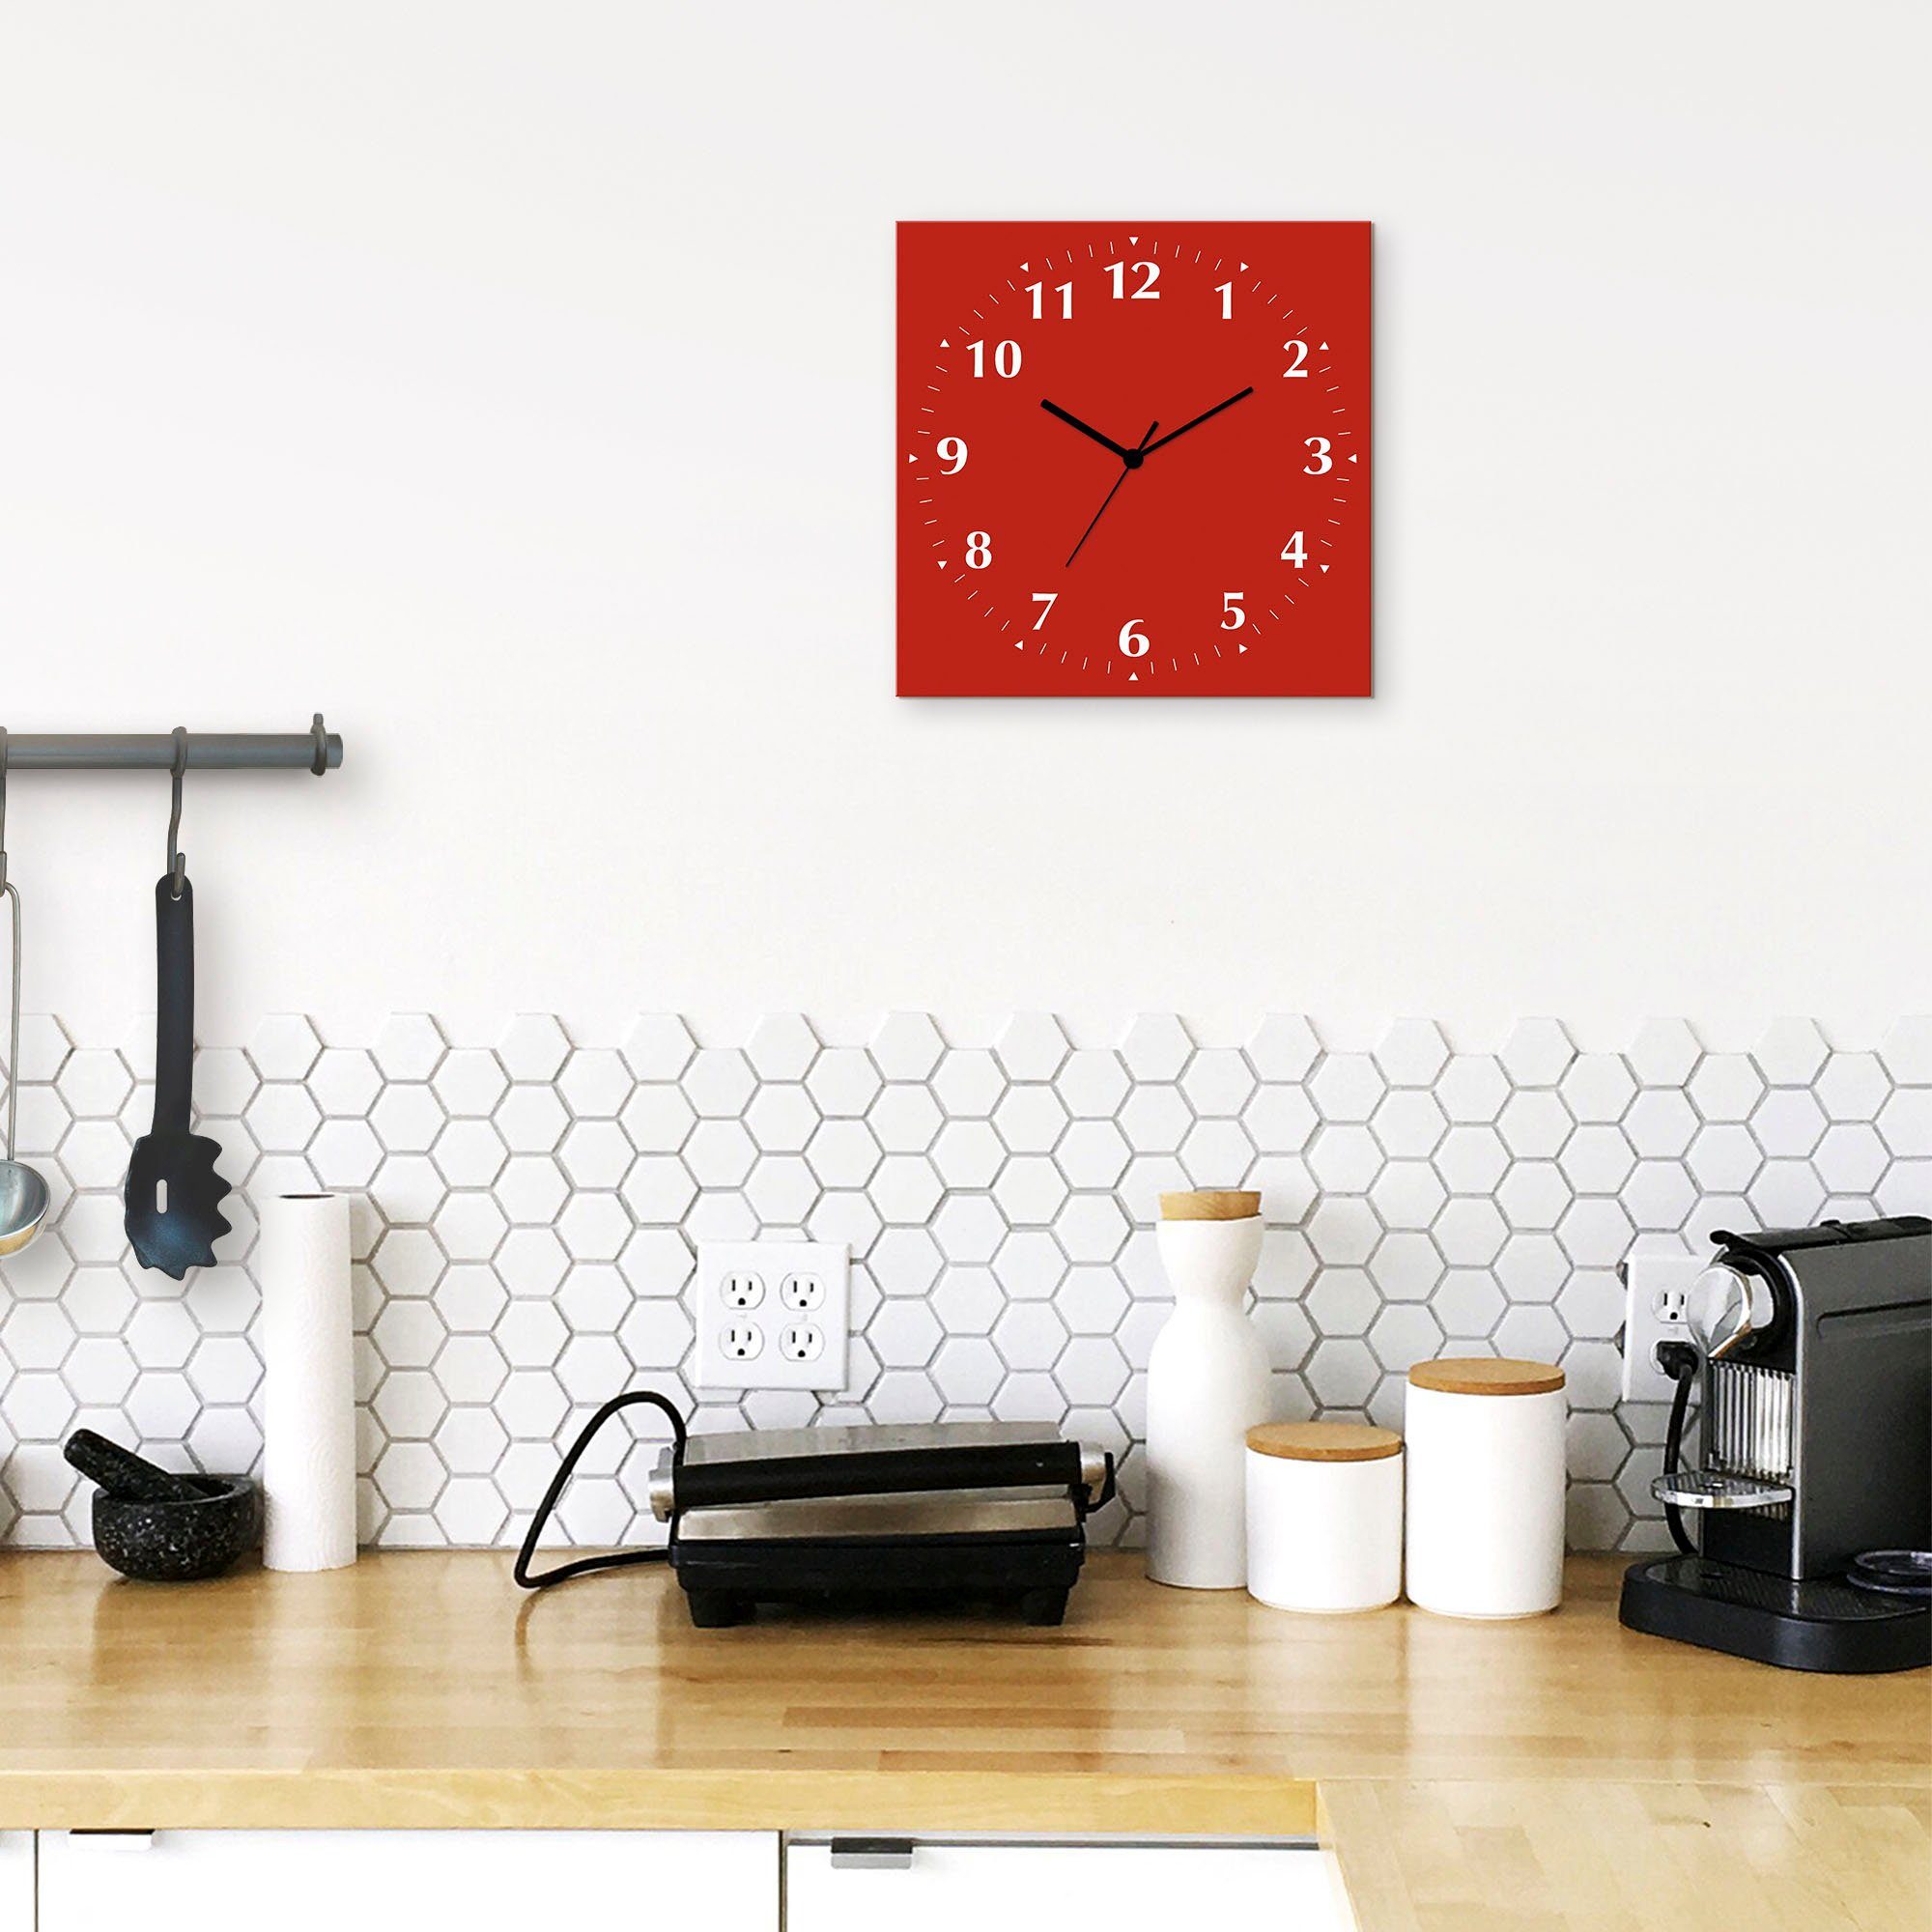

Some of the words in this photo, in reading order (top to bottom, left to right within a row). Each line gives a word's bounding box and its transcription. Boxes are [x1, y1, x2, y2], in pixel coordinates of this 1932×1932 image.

[1103, 261, 1161, 299] 12
[1024, 281, 1074, 320] 11
[1213, 281, 1233, 320] 1
[965, 339, 1023, 379] 10
[1283, 339, 1309, 378] 2
[936, 437, 969, 475] 9
[1302, 437, 1333, 475] 3
[964, 530, 993, 570] 8
[1280, 530, 1308, 569] 4
[1031, 592, 1059, 631] 7
[1220, 591, 1246, 630] 5
[1118, 618, 1151, 658] 6
